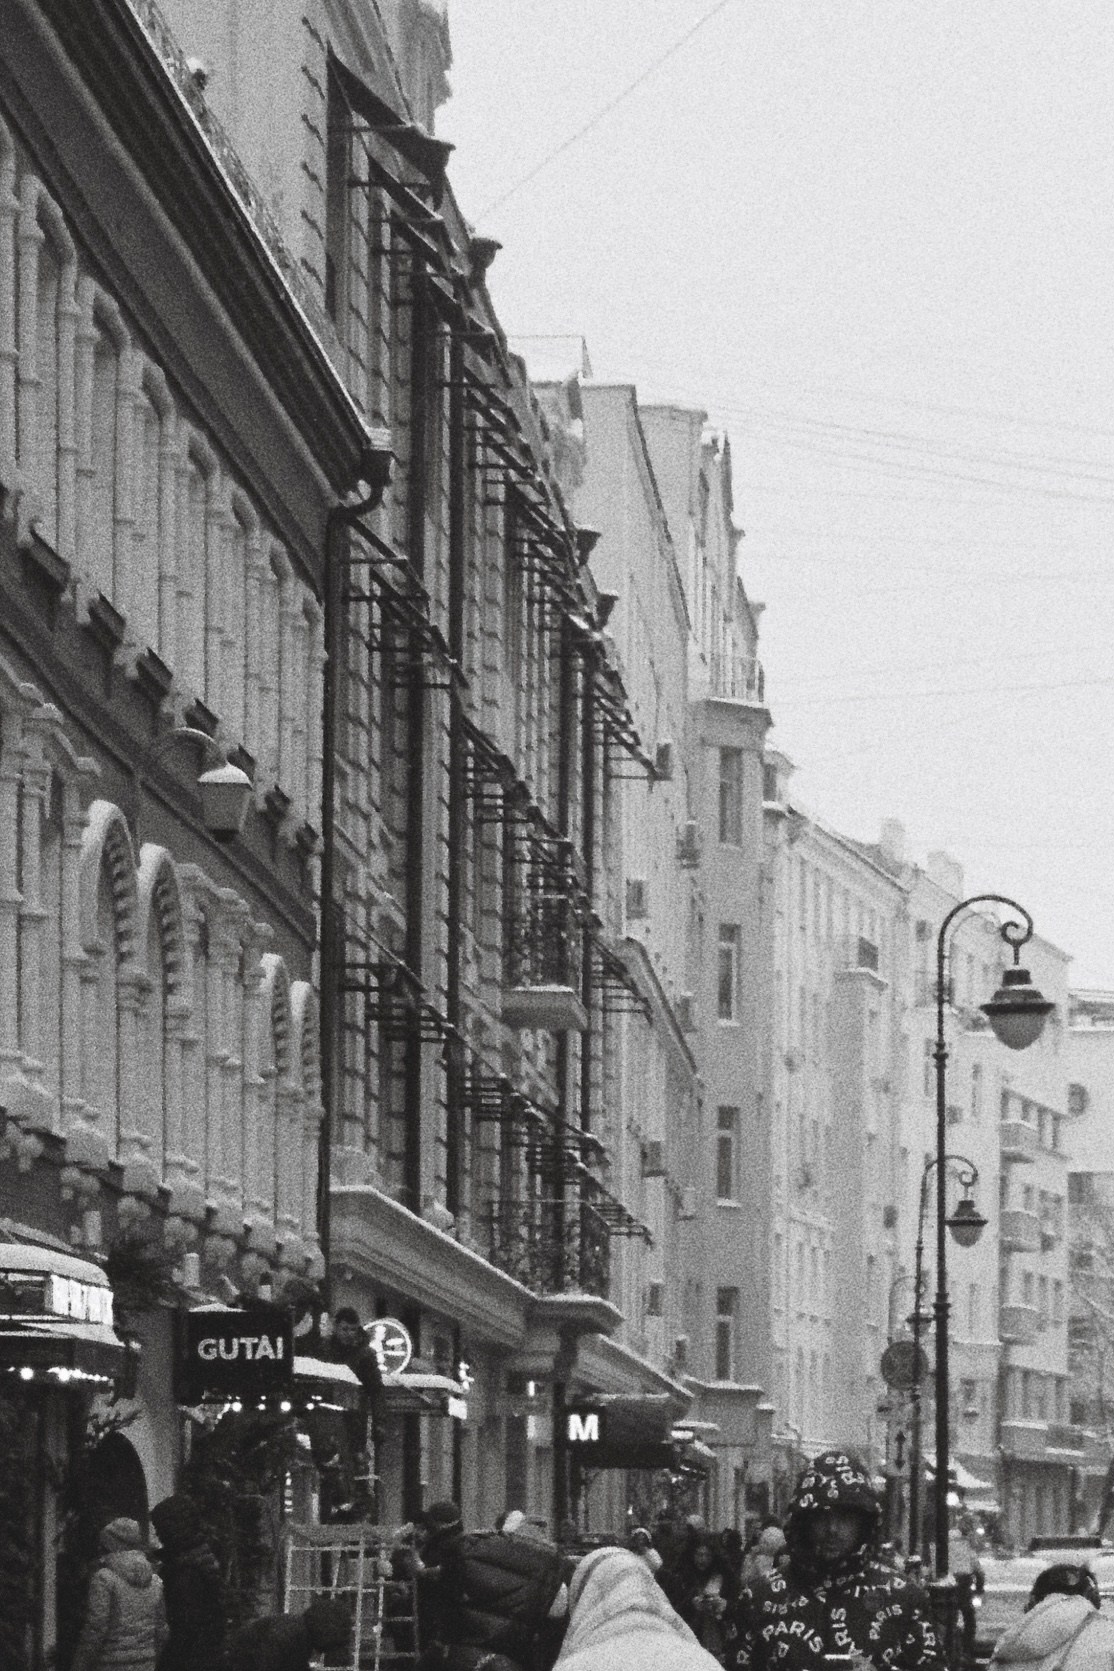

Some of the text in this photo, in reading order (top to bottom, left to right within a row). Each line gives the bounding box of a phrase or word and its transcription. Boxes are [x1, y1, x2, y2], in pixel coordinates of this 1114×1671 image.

[197, 1334, 284, 1360] GUTAI
[568, 1413, 599, 1441] M
[762, 1620, 824, 1653] PARIS
[830, 1607, 864, 1656] ARIS
